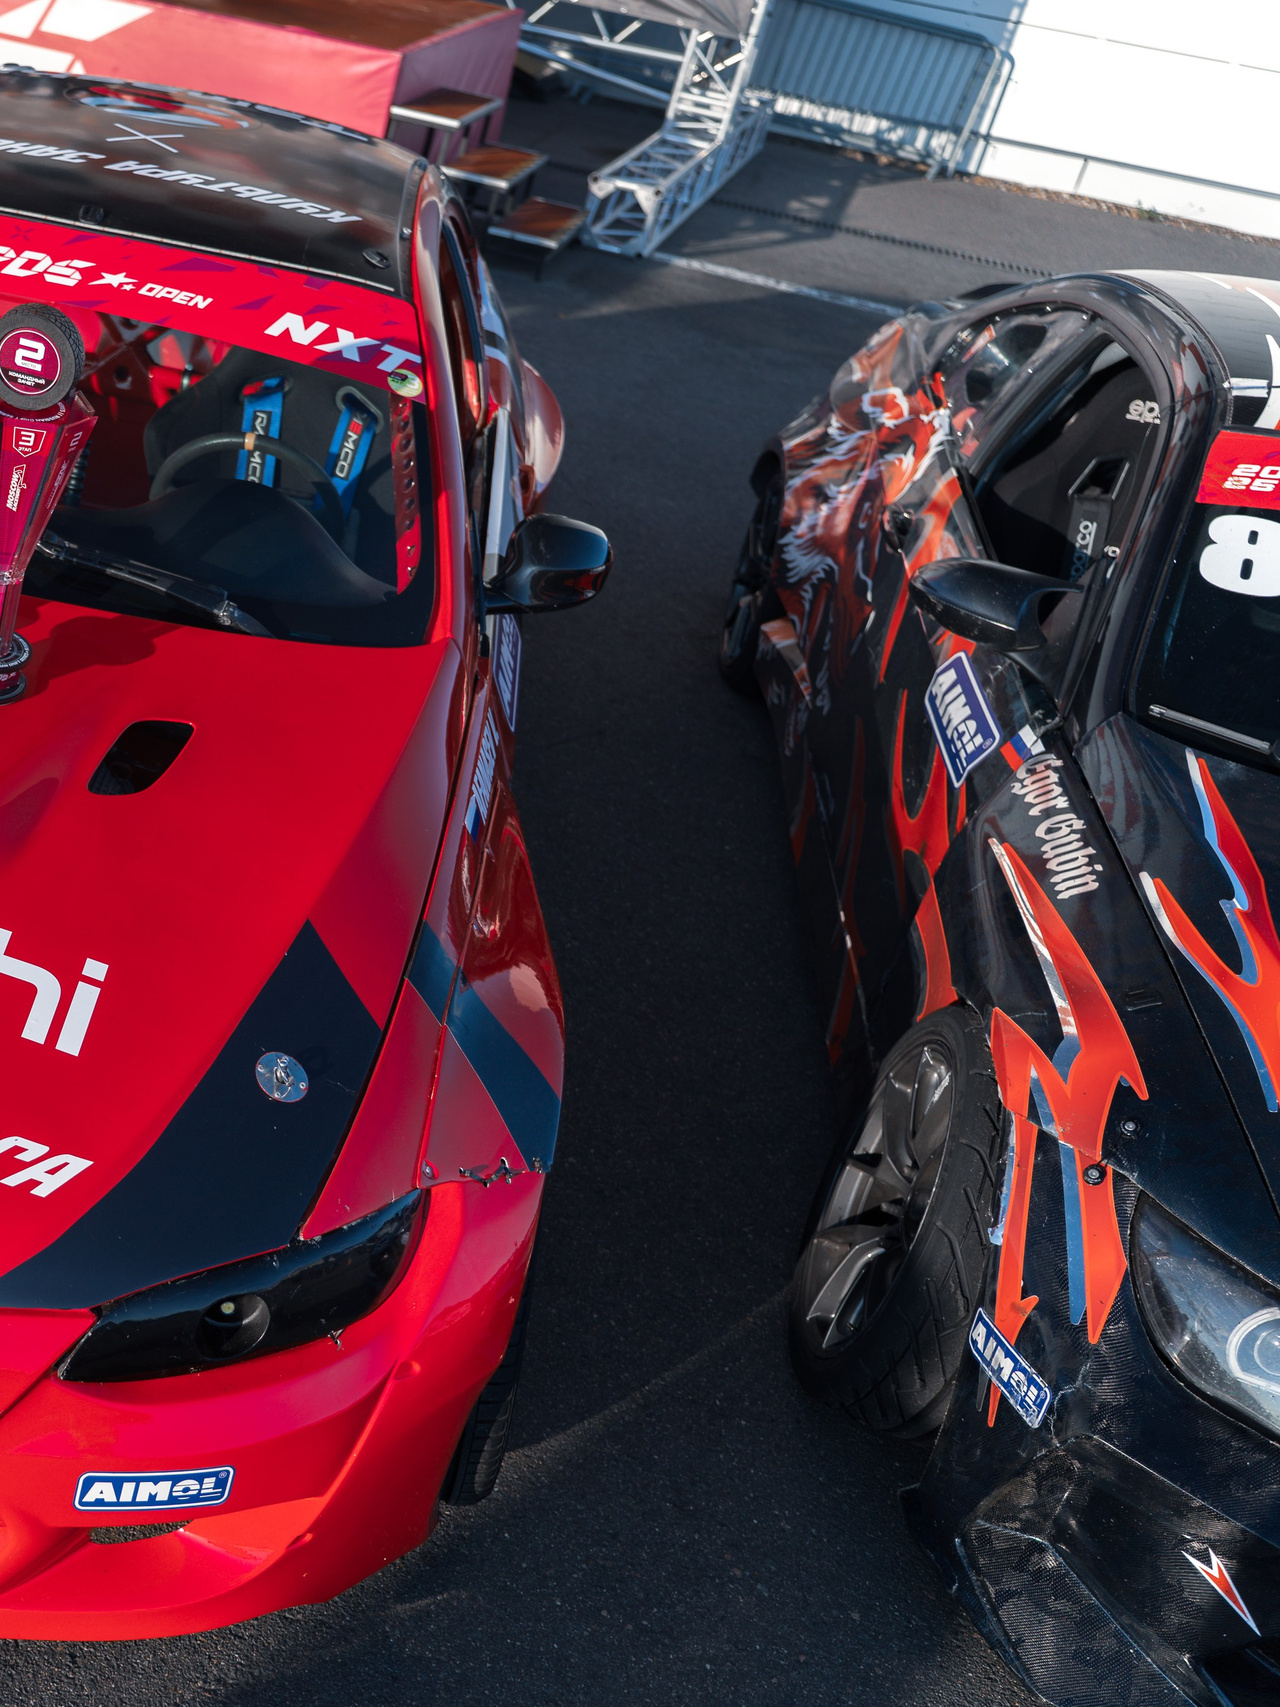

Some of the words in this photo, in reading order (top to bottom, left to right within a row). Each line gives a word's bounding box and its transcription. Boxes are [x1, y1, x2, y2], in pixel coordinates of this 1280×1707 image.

[103, 159, 363, 225] КУЛЬТУРА
[136, 282, 214, 310] OPEN
[14, 337, 46, 372] 2
[263, 311, 423, 373] NXT
[8, 370, 46, 385] КОМАНДНЫЙ
[21, 361, 37, 369] МЕСТО
[18, 430, 36, 447] 3
[1222, 475, 1280, 492] 25
[1231, 463, 1280, 479] 20
[6, 470, 20, 509] MOSCOW
[931, 666, 984, 773] AIMOL
[1010, 752, 1070, 817] Egor
[1034, 812, 1104, 901] Gubin
[971, 1320, 1041, 1413] AIMOL
[81, 1476, 223, 1503] AIMOL
